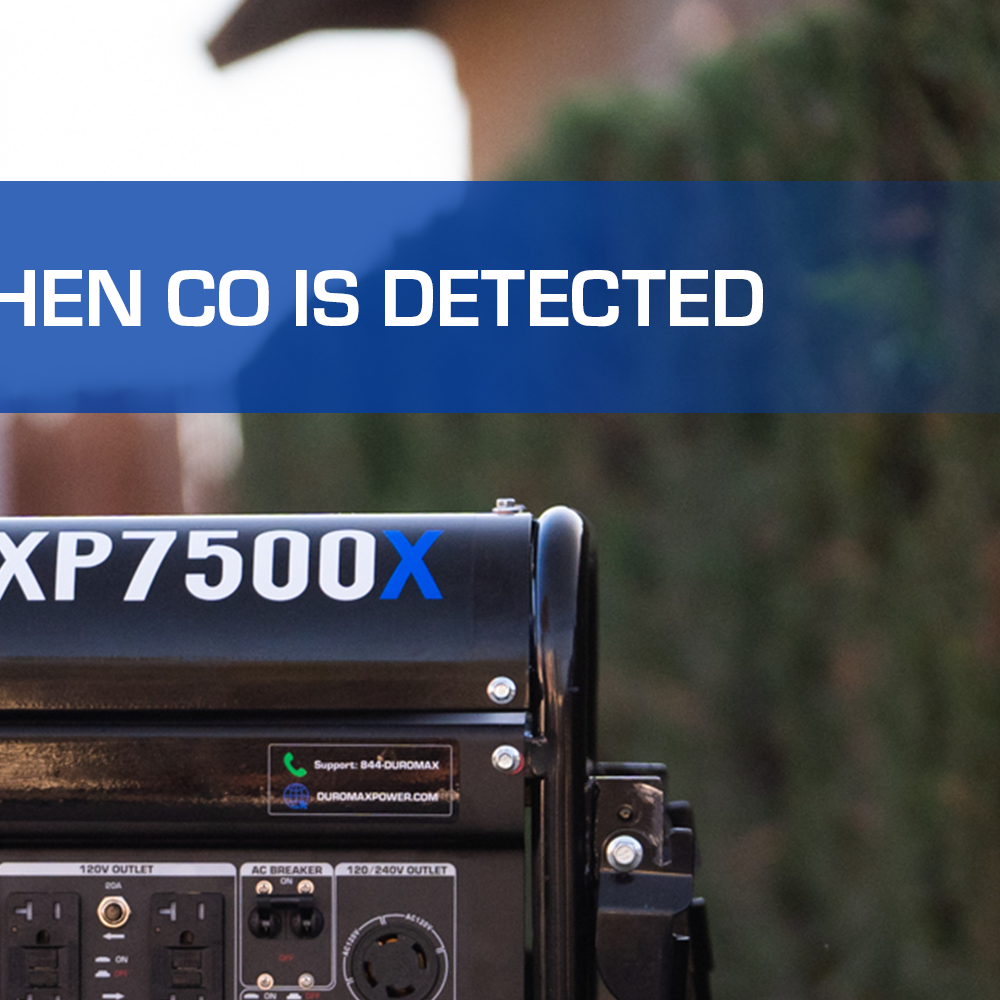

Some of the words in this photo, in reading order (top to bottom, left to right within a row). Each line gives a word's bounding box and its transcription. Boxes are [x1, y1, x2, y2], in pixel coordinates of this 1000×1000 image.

[314, 760, 358, 771] Support:
[360, 760, 440, 770] 844-DUROMAX
[316, 792, 439, 802] DUROMAXPOWER.COM
[79, 865, 110, 874] 120V
[112, 865, 154, 874] OUTLET
[252, 866, 268, 874] AC
[270, 866, 323, 874] BREAKER
[406, 866, 448, 874] OUTLET
[115, 956, 129, 964] ON
[264, 992, 277, 1000] ON
